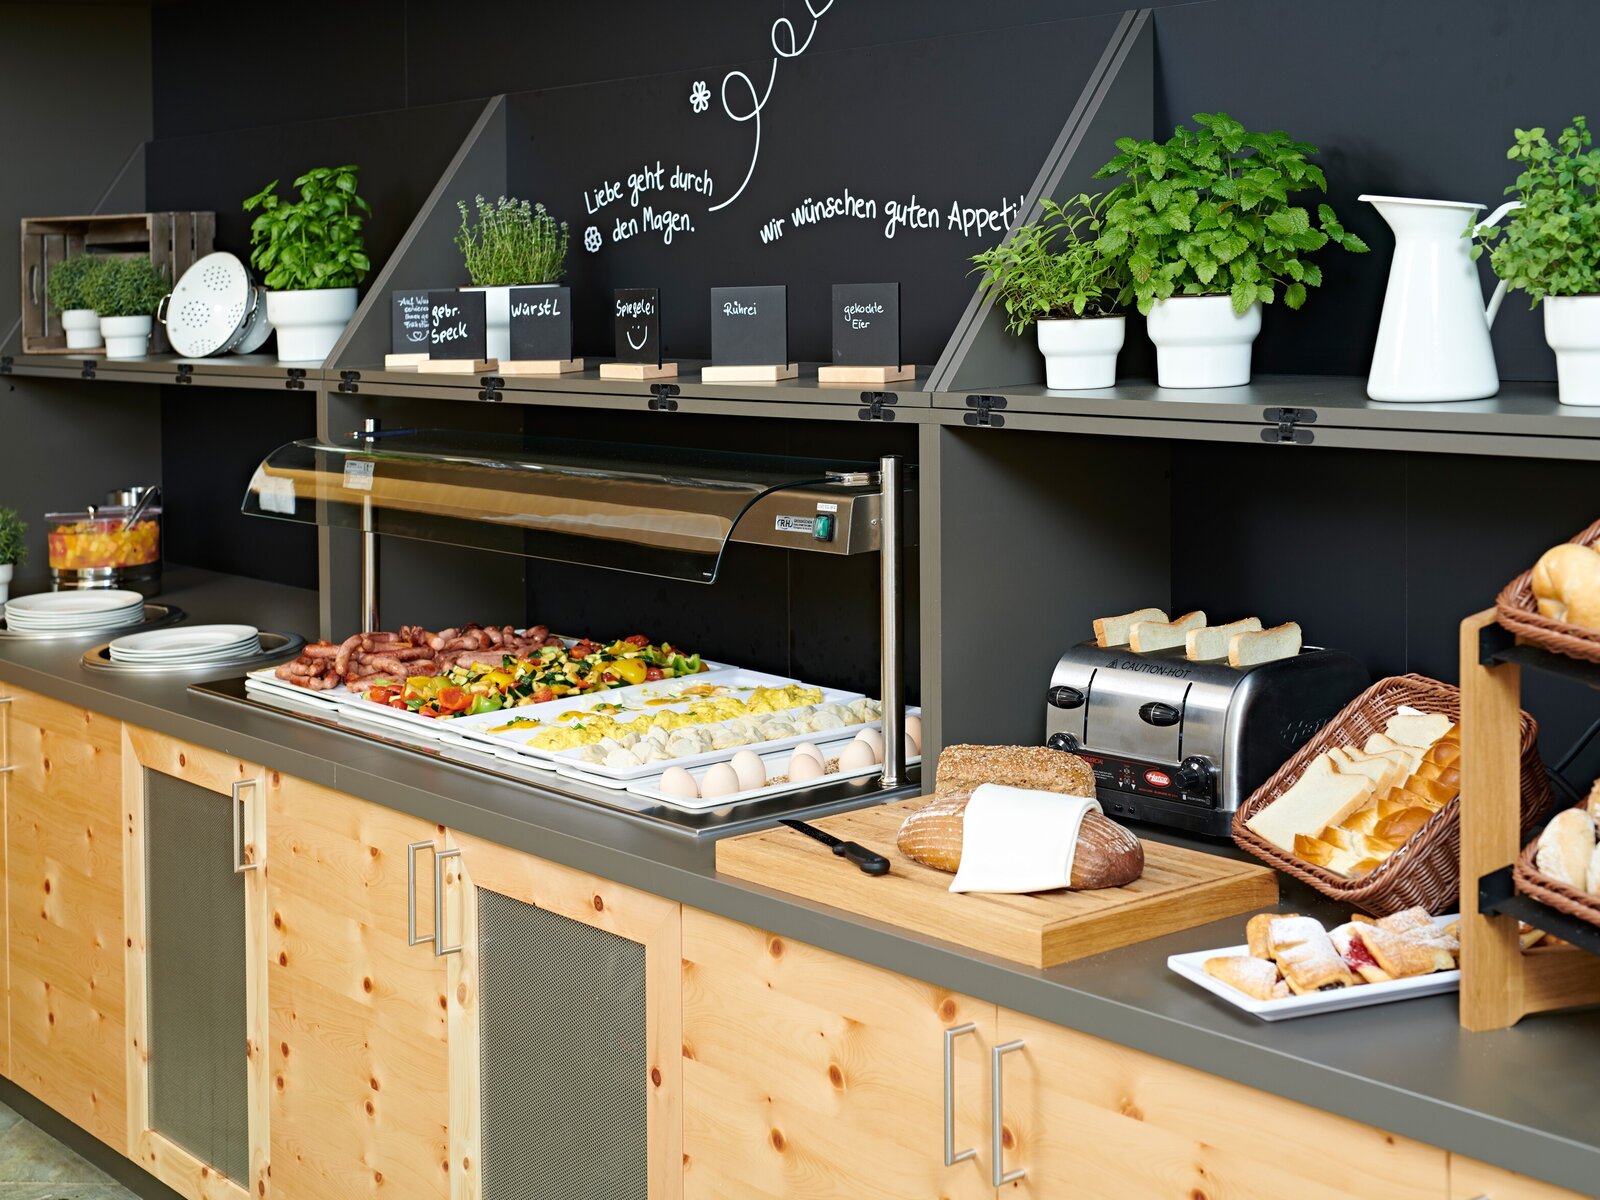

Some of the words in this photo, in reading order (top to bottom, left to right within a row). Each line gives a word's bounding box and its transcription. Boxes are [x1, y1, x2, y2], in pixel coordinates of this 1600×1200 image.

[585, 180, 624, 215] Liebe
[627, 160, 665, 208] geht
[669, 164, 713, 197] durch
[791, 187, 877, 228] wünschen
[884, 194, 940, 239] guten
[612, 217, 639, 242] den
[642, 205, 695, 245] Magen.
[431, 303, 461, 327] gebr.
[616, 296, 655, 319] Spiegelei
[722, 300, 758, 317] Rührei
[843, 301, 885, 322] gekochte
[851, 318, 871, 330] Eier
[1121, 661, 1192, 679] CAUTION-HOT
